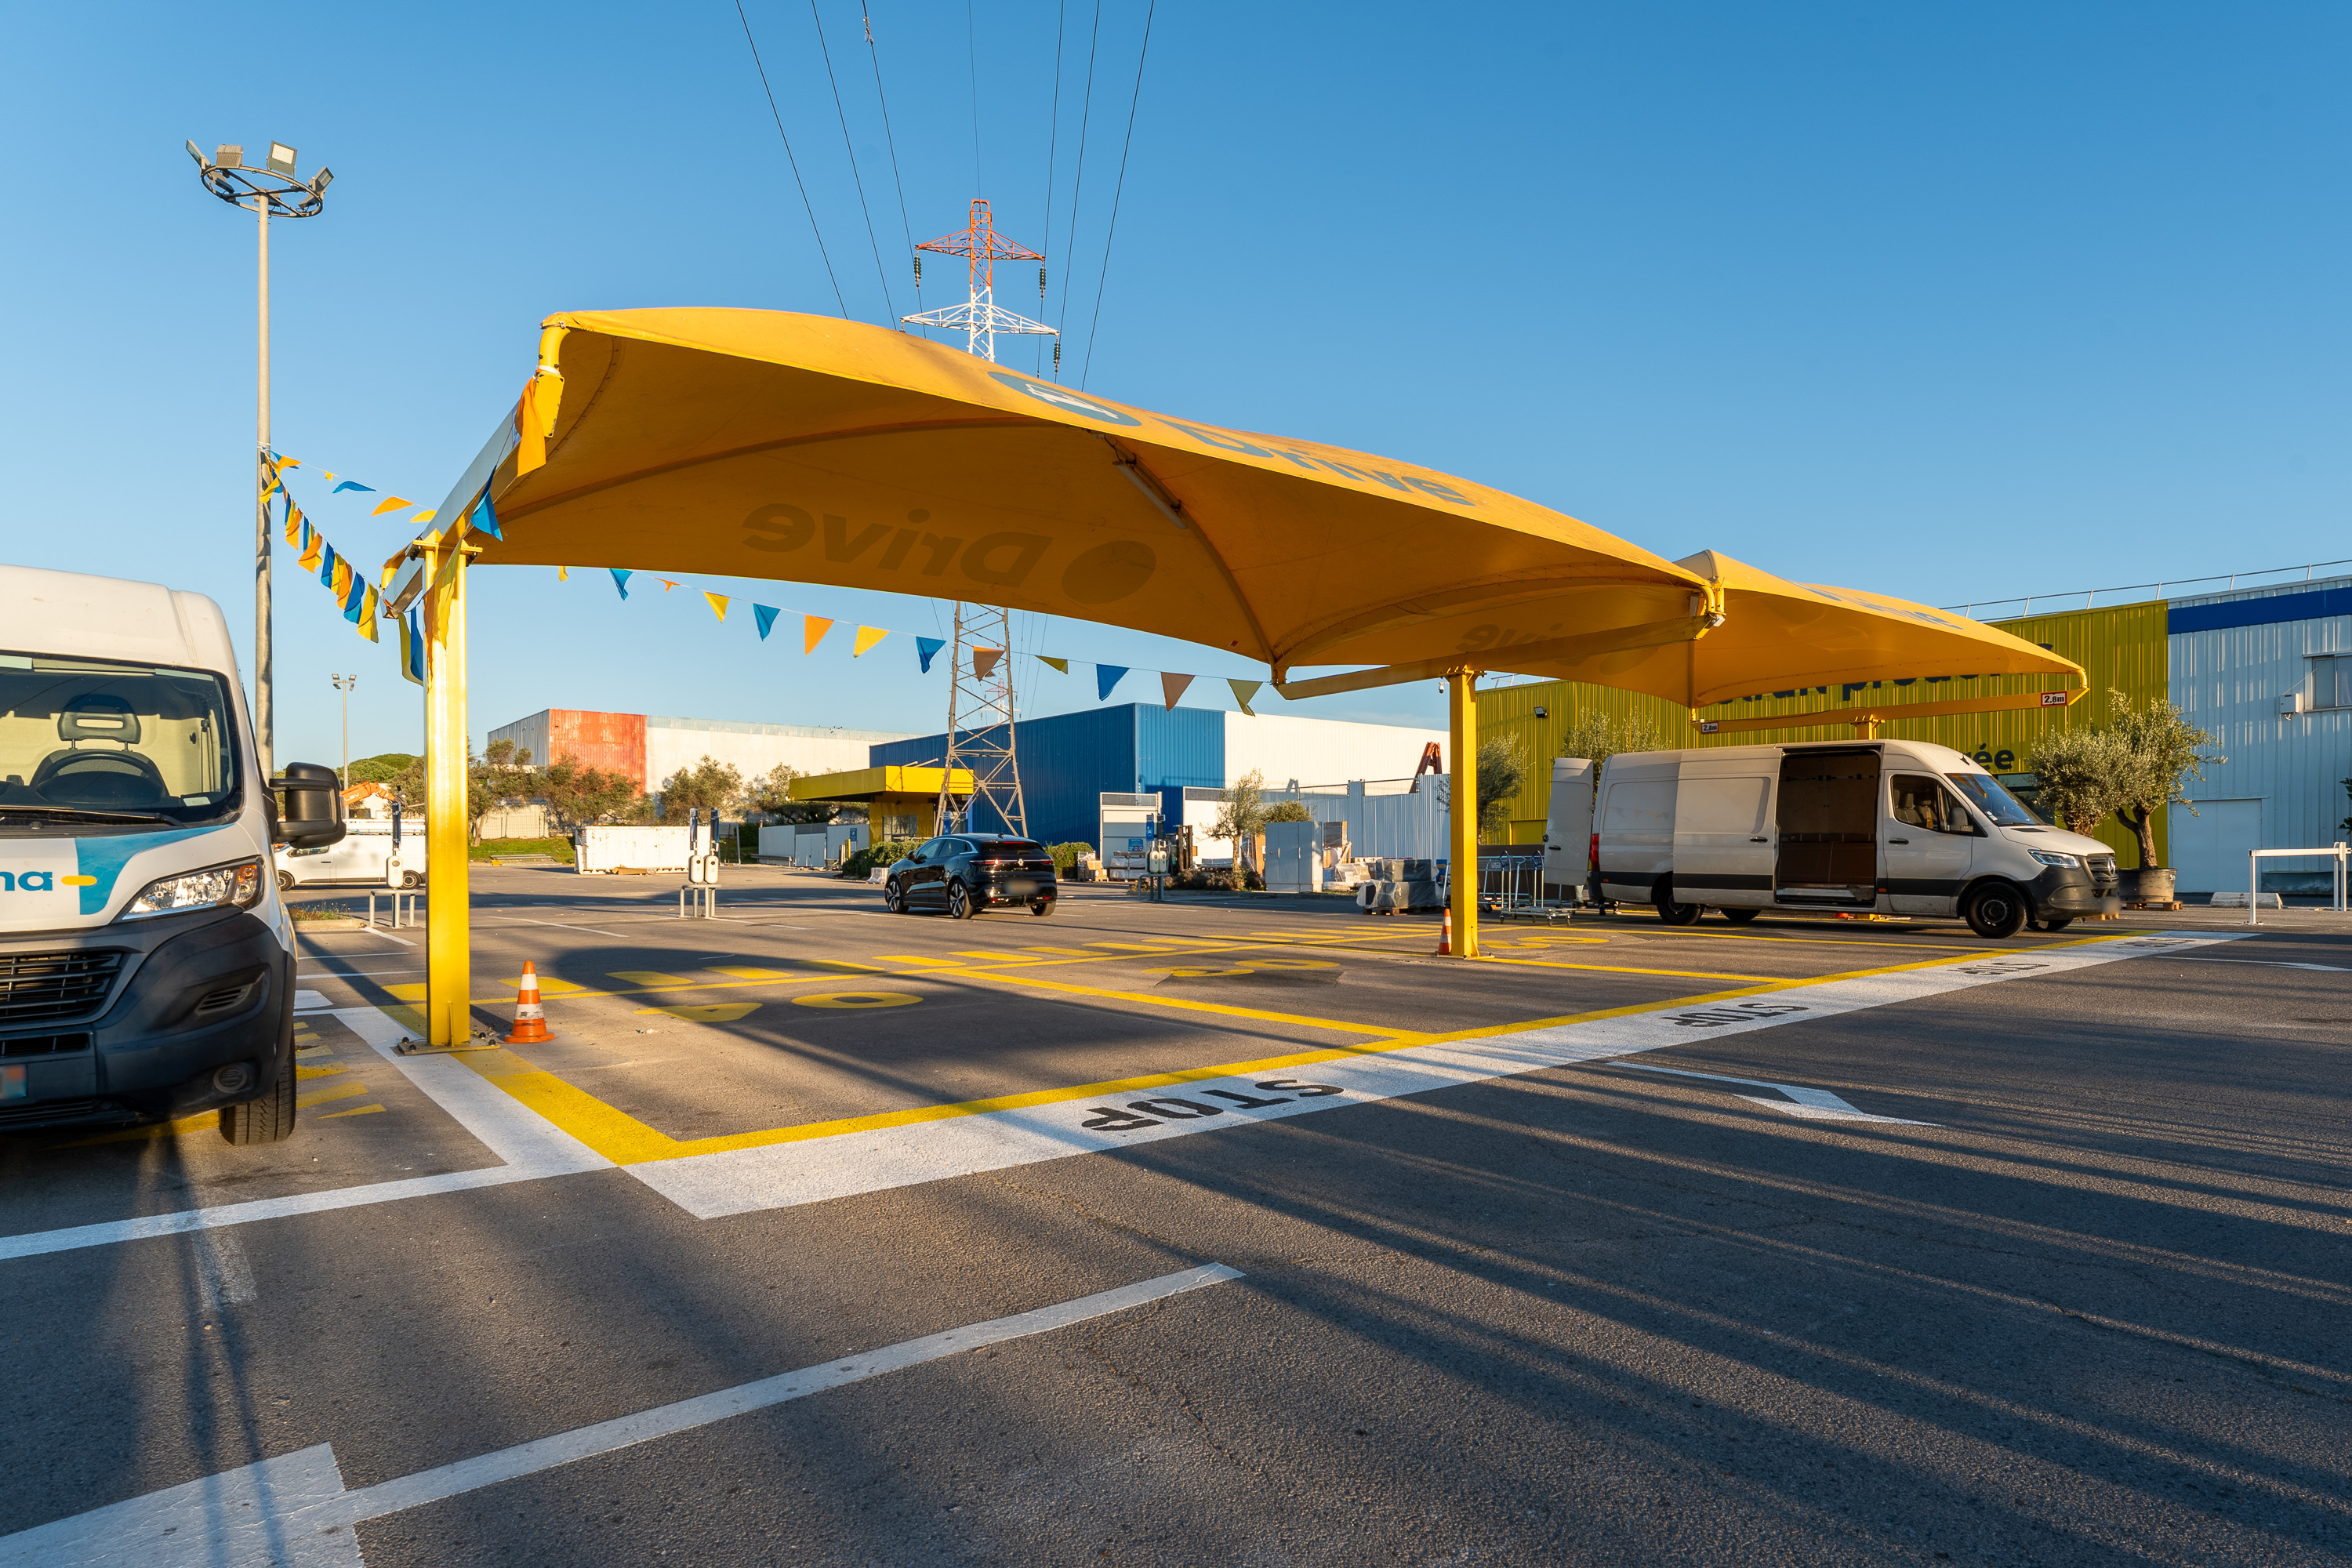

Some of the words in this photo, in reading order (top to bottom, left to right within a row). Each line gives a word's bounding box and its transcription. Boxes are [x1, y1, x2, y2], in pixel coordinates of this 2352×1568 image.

[1150, 416, 1476, 507] Drive
[2044, 695, 2065, 704] 2,8m
[1660, 1003, 1809, 1028] STOP
[1080, 1079, 1345, 1131] STOP
